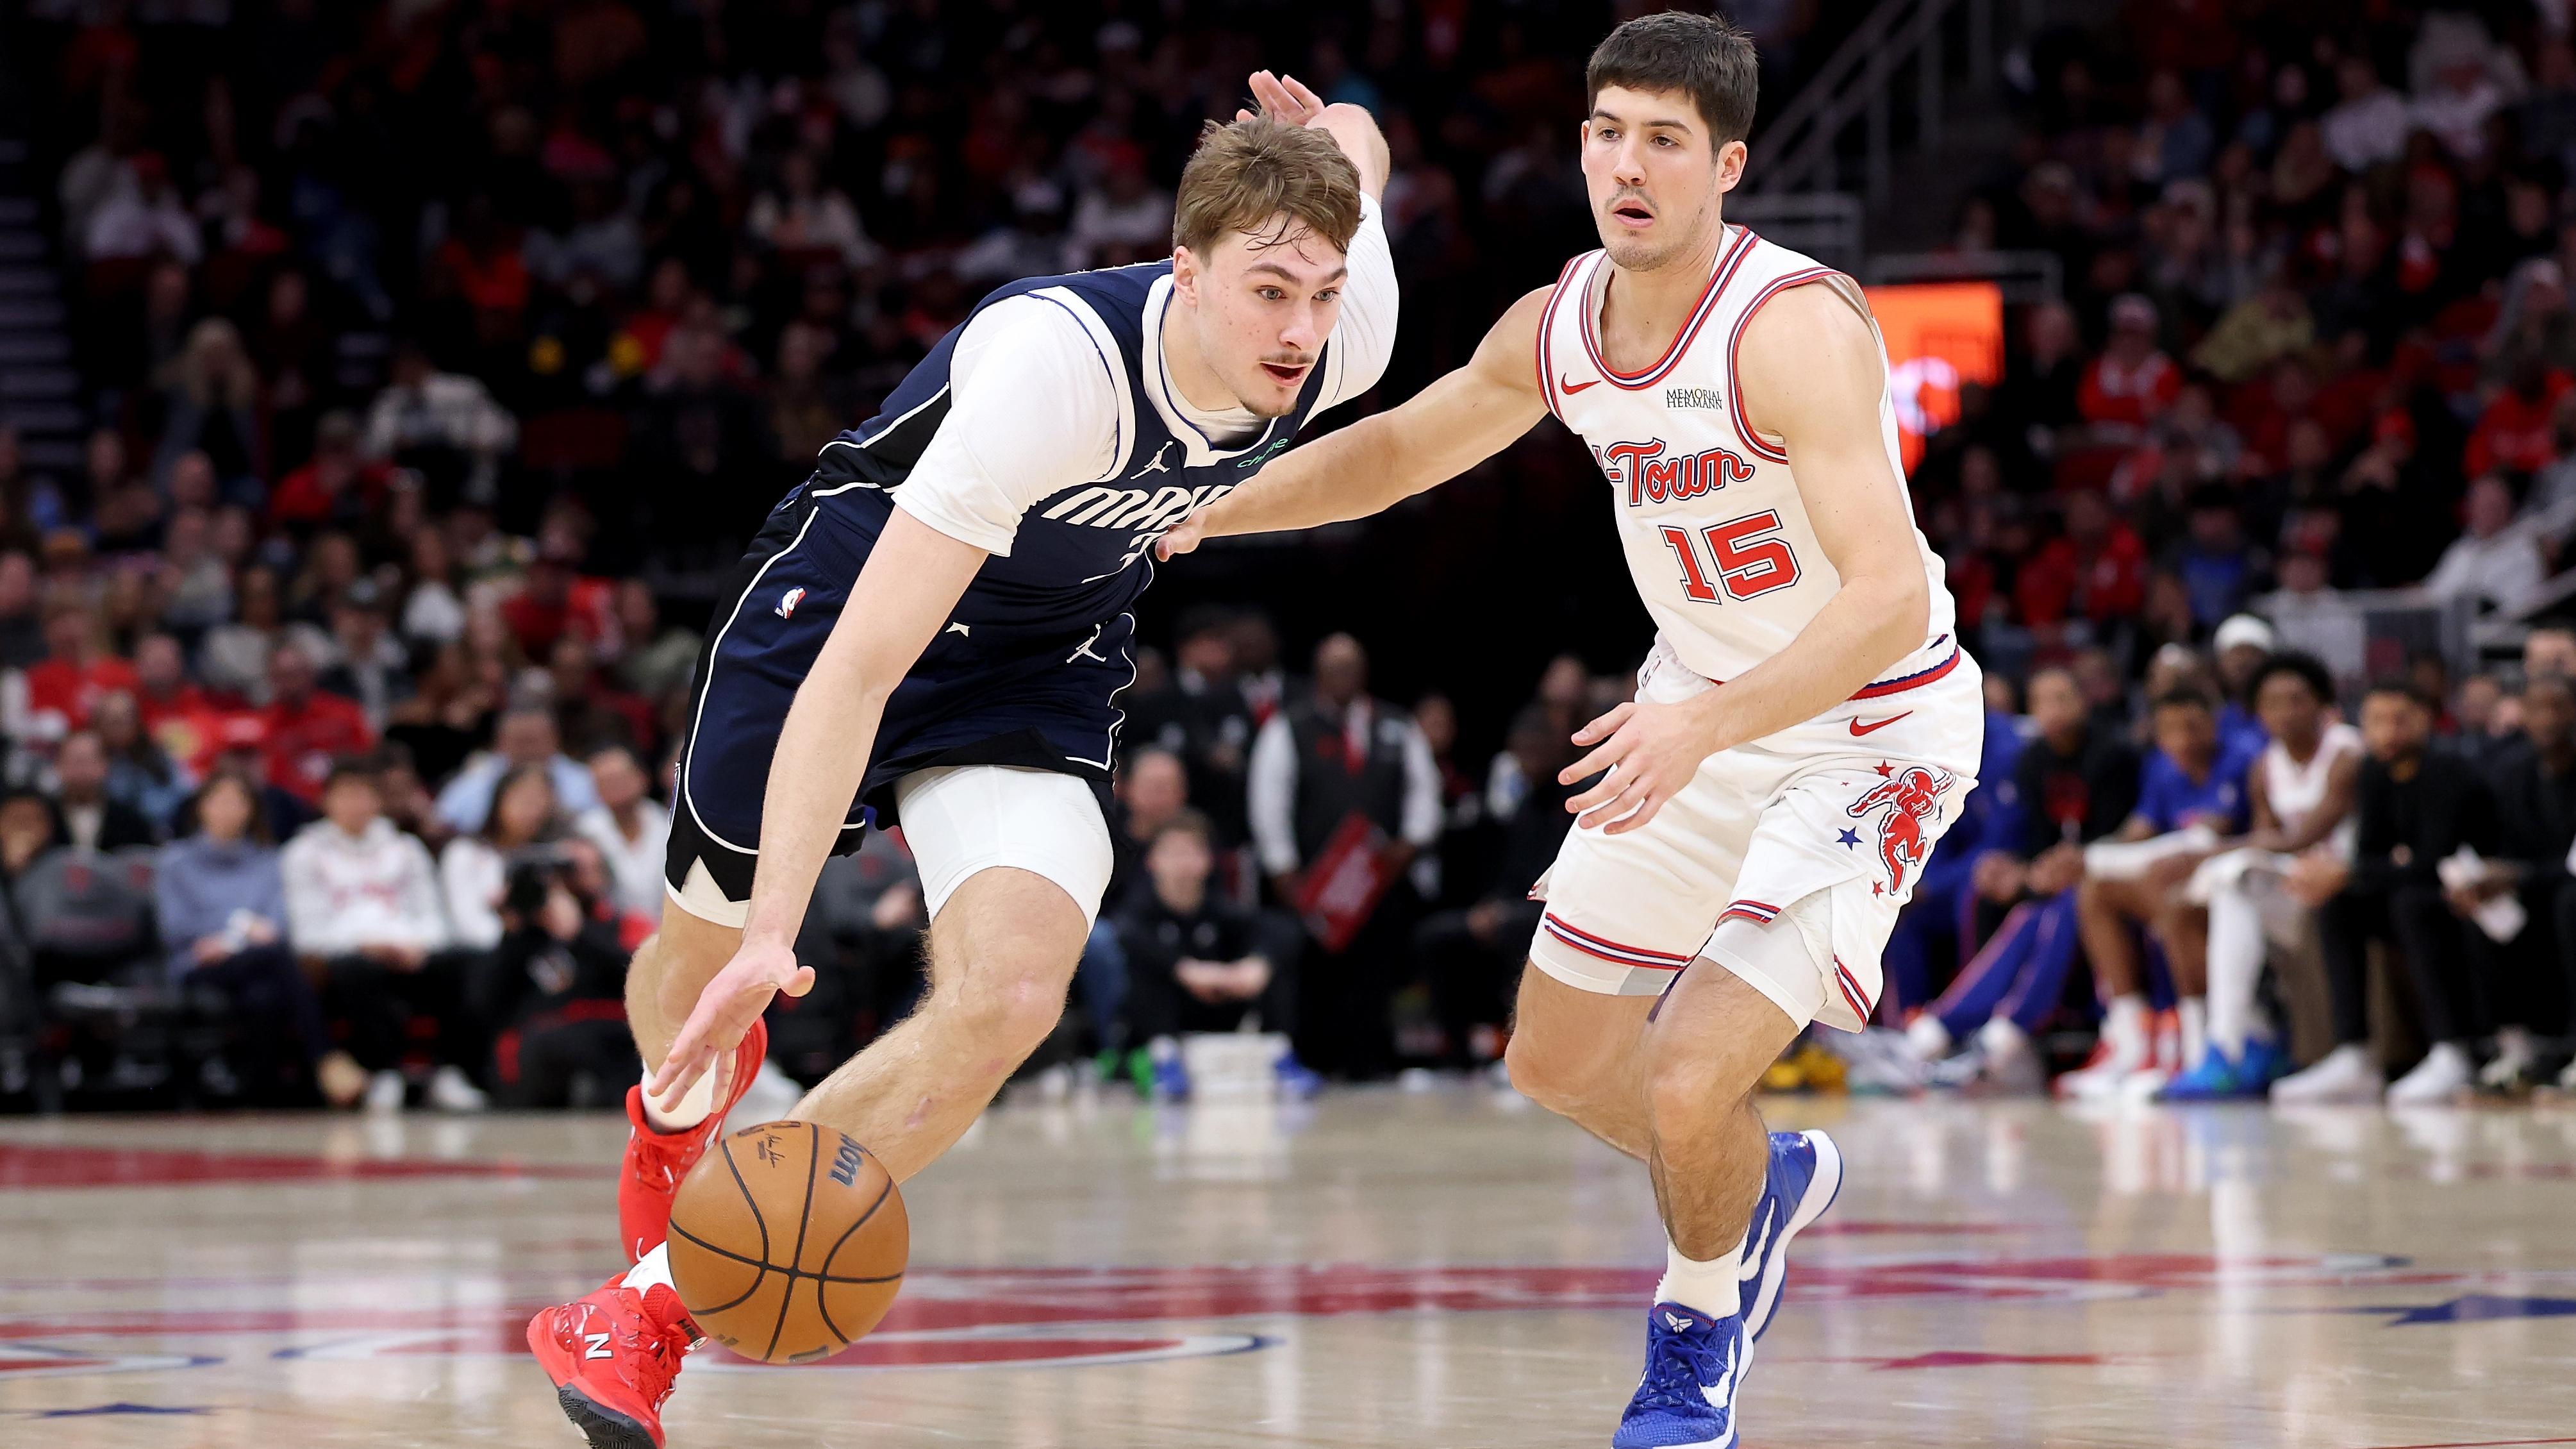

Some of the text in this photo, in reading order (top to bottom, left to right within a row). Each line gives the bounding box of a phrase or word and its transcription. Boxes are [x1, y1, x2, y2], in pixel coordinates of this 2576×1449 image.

[1666, 389, 1722, 401] MEMORIAL
[1666, 397, 1723, 410] HERMANN
[1040, 485, 1234, 532] MAV
[1658, 508, 1802, 605] 15
